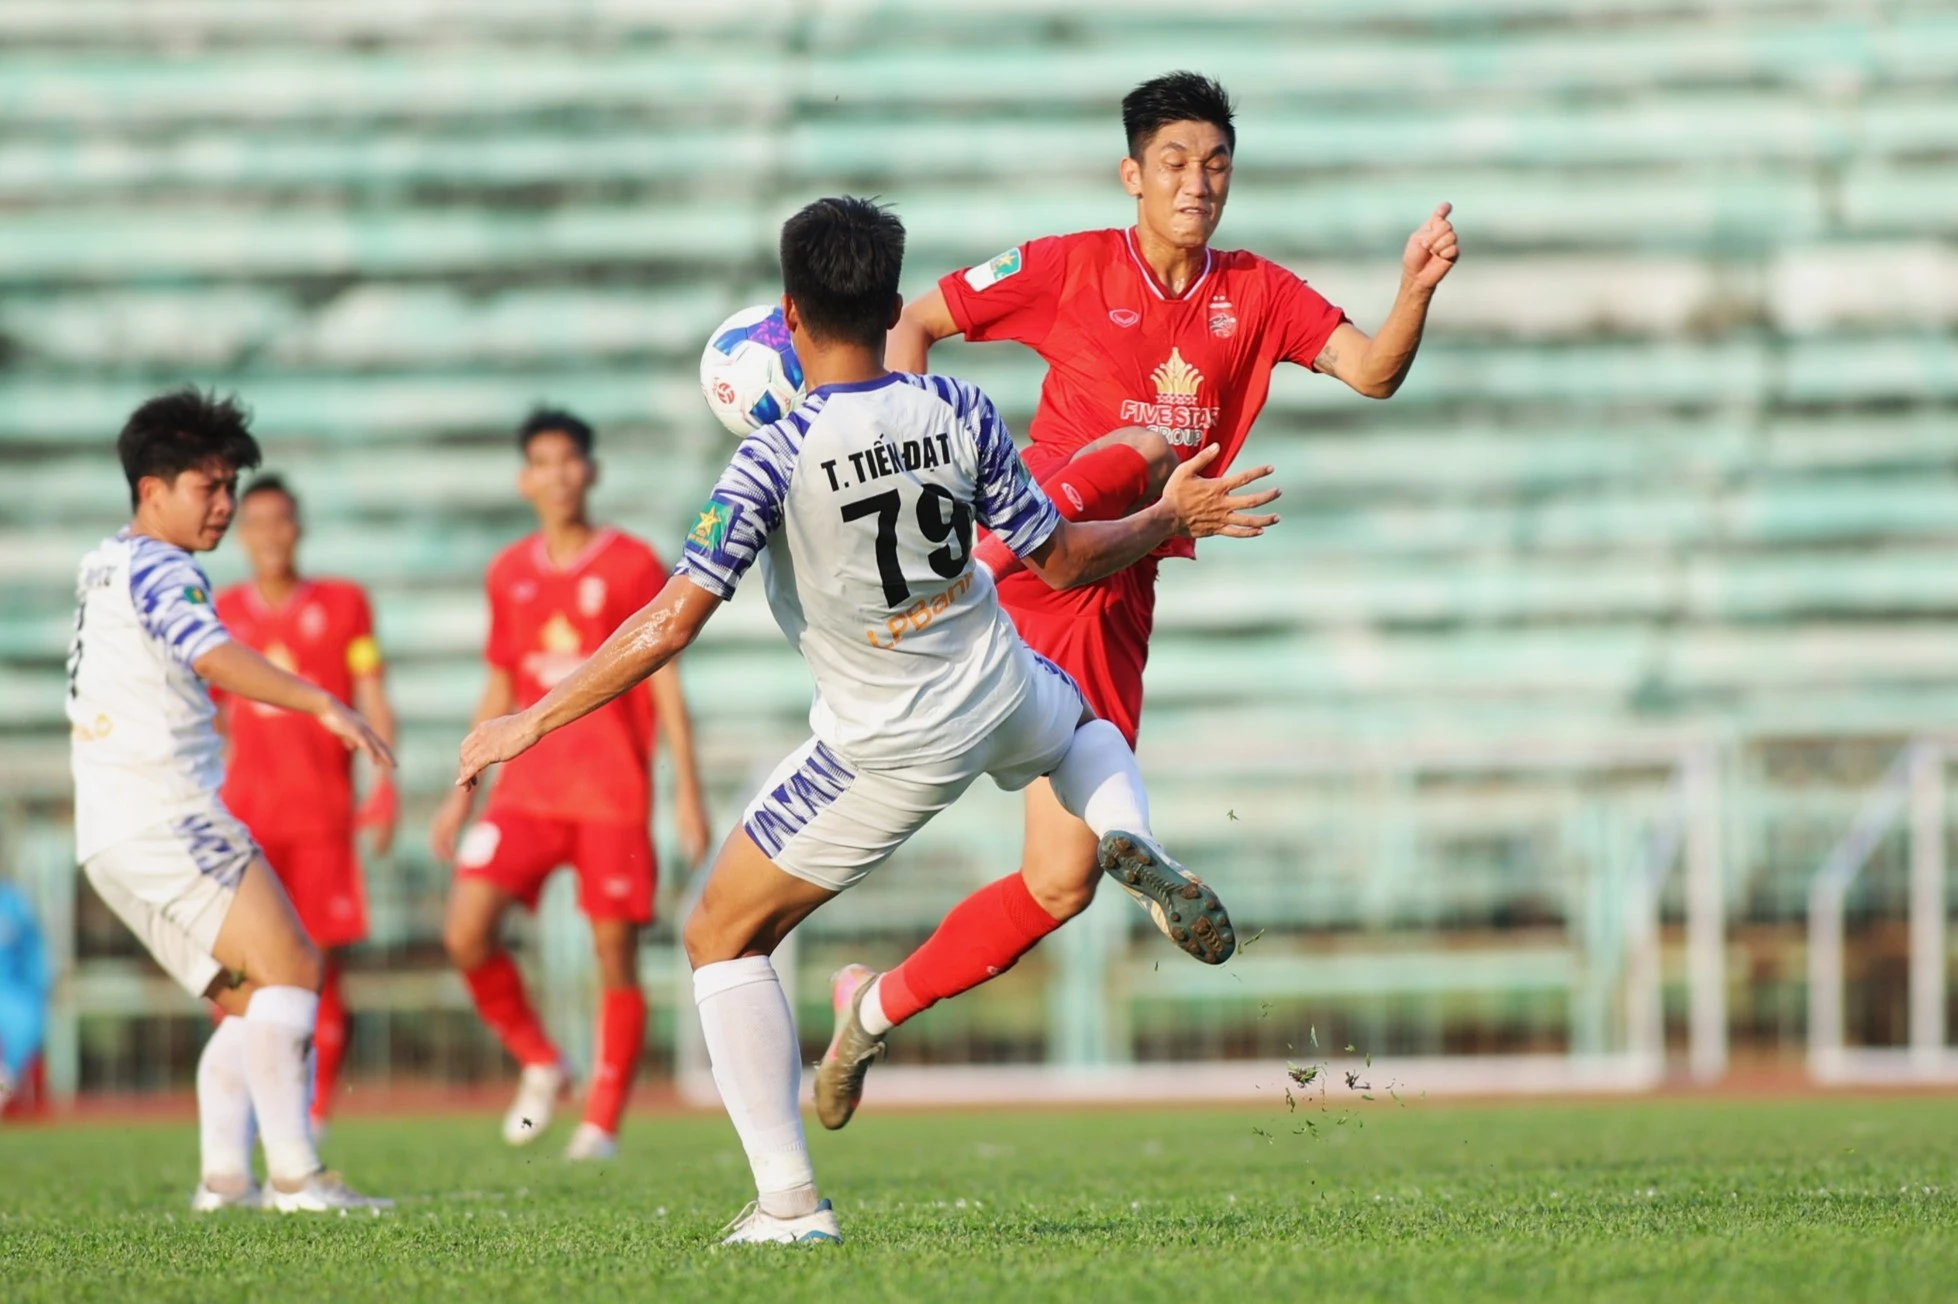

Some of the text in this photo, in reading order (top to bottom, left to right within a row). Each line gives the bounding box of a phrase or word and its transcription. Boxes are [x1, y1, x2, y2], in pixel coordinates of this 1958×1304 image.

[1120, 399, 1173, 426] FIVE
[820, 458, 850, 492] T.
[902, 432, 951, 473] ĐẠT
[840, 483, 974, 609] 79
